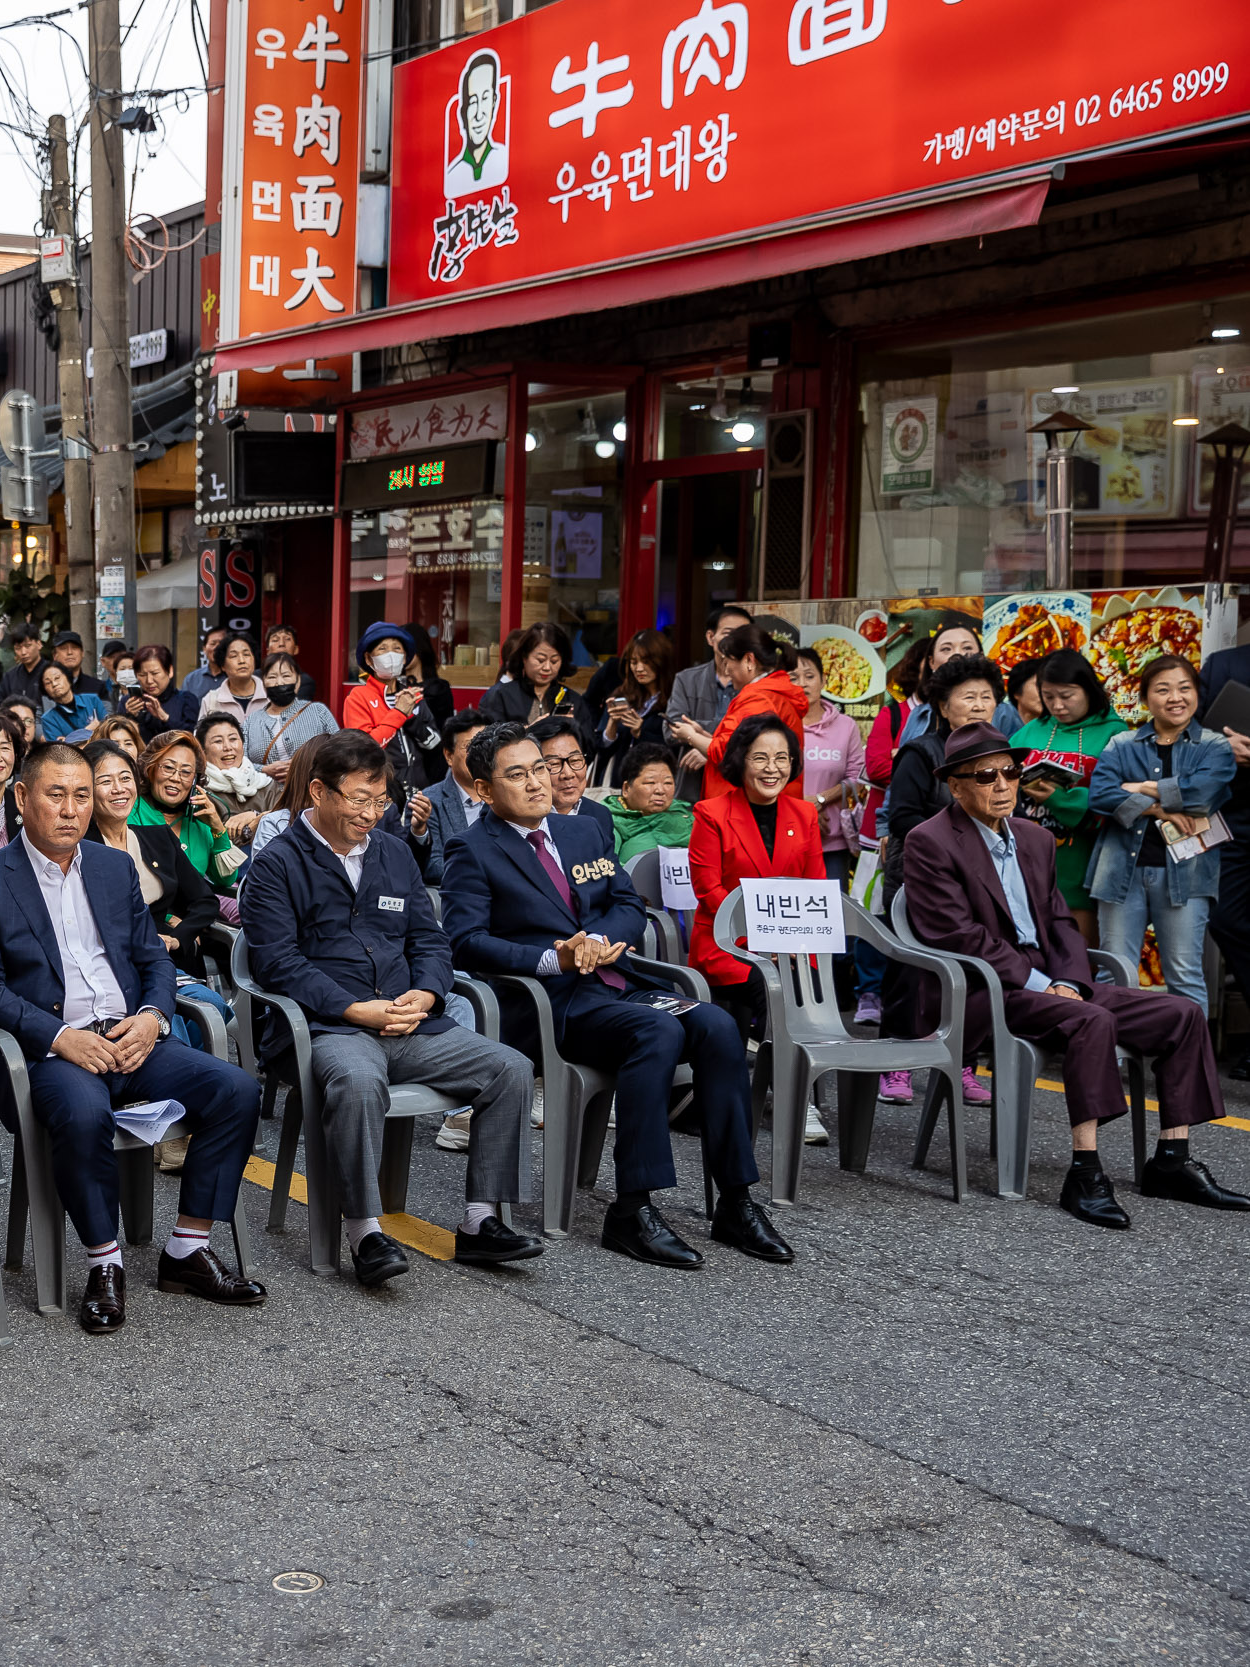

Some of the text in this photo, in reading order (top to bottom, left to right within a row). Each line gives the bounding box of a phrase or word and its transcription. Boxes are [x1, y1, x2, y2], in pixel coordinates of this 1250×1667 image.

[547, 0, 962, 138] 牛肉面
[922, 62, 1230, 165] 가맹/예약문의 02 6465 8999
[547, 113, 738, 223] 우육면대왕
[283, 0, 349, 381] 牛肉面大
[374, 402, 499, 448] 民以食为天
[803, 745, 842, 761] idas
[571, 857, 616, 886] 오신환
[663, 864, 691, 885] 내빈
[756, 893, 829, 919] 내빈석
[777, 925, 814, 935] 광진구의회
[816, 925, 833, 935] 의장
